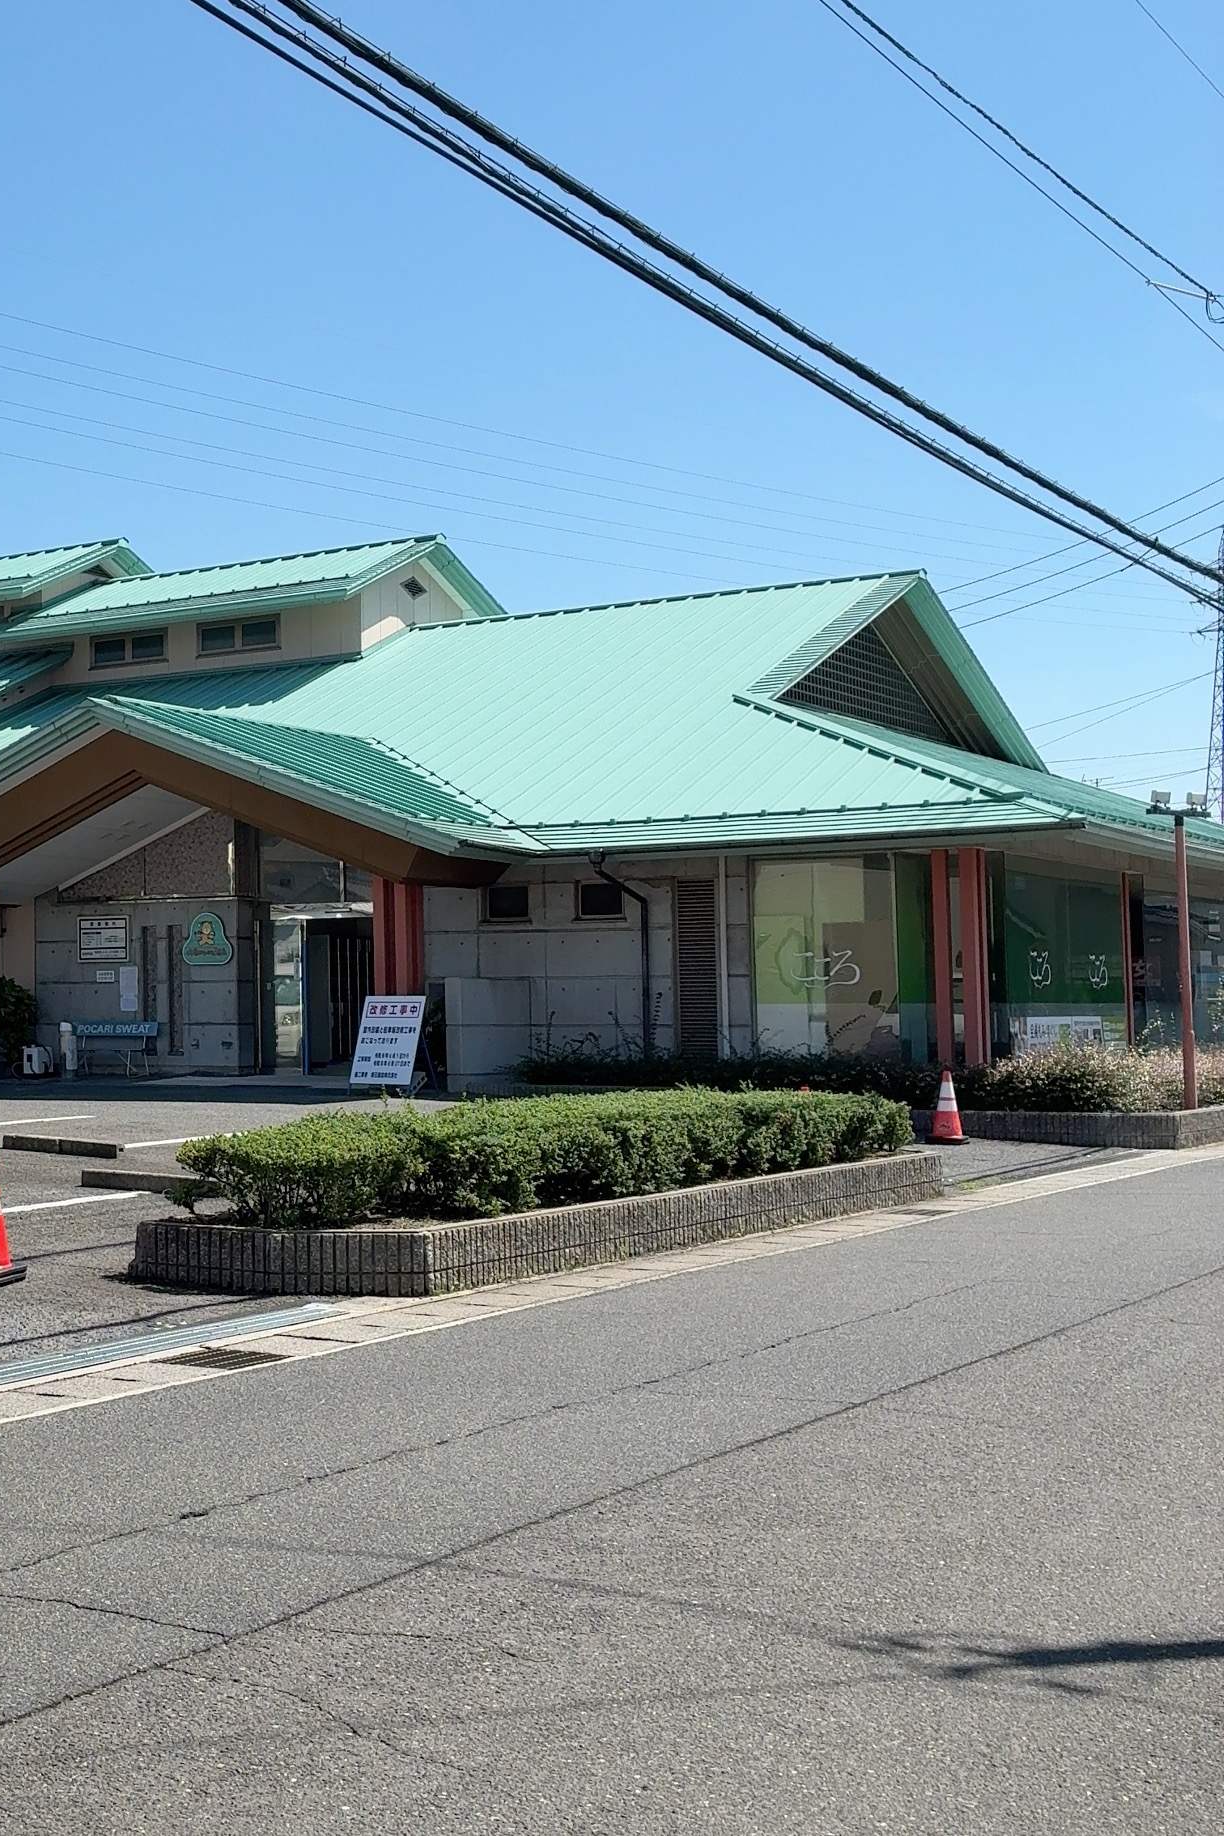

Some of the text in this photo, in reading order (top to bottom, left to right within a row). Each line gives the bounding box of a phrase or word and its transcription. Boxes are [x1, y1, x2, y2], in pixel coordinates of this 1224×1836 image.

[790, 949, 861, 989] こころ
[369, 1005, 418, 1015] 改修工事中
[77, 1024, 150, 1034] POCARI SWEAT
